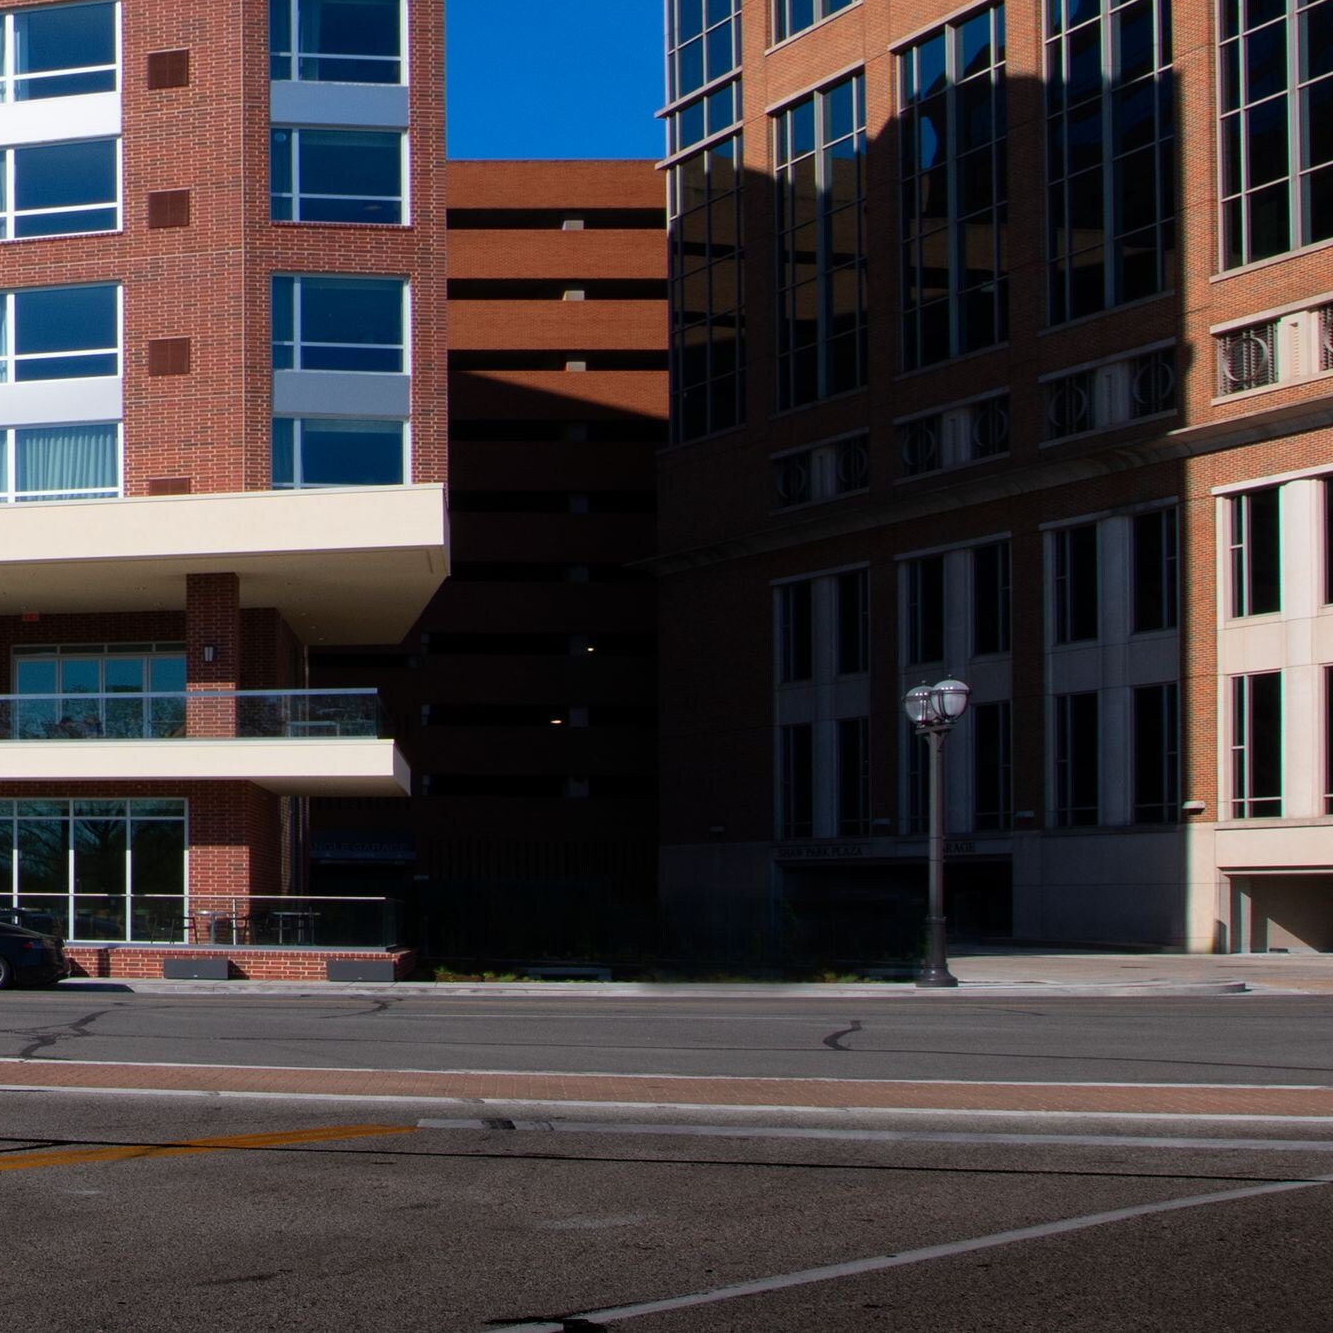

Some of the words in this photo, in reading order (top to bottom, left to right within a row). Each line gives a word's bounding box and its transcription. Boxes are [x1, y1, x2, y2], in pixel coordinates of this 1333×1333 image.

[352, 842, 407, 851] GARAGE
[779, 848, 803, 858] SHAW
[806, 848, 830, 857] PARK
[832, 846, 863, 856] PLAZA
[944, 842, 975, 853] RAGE
